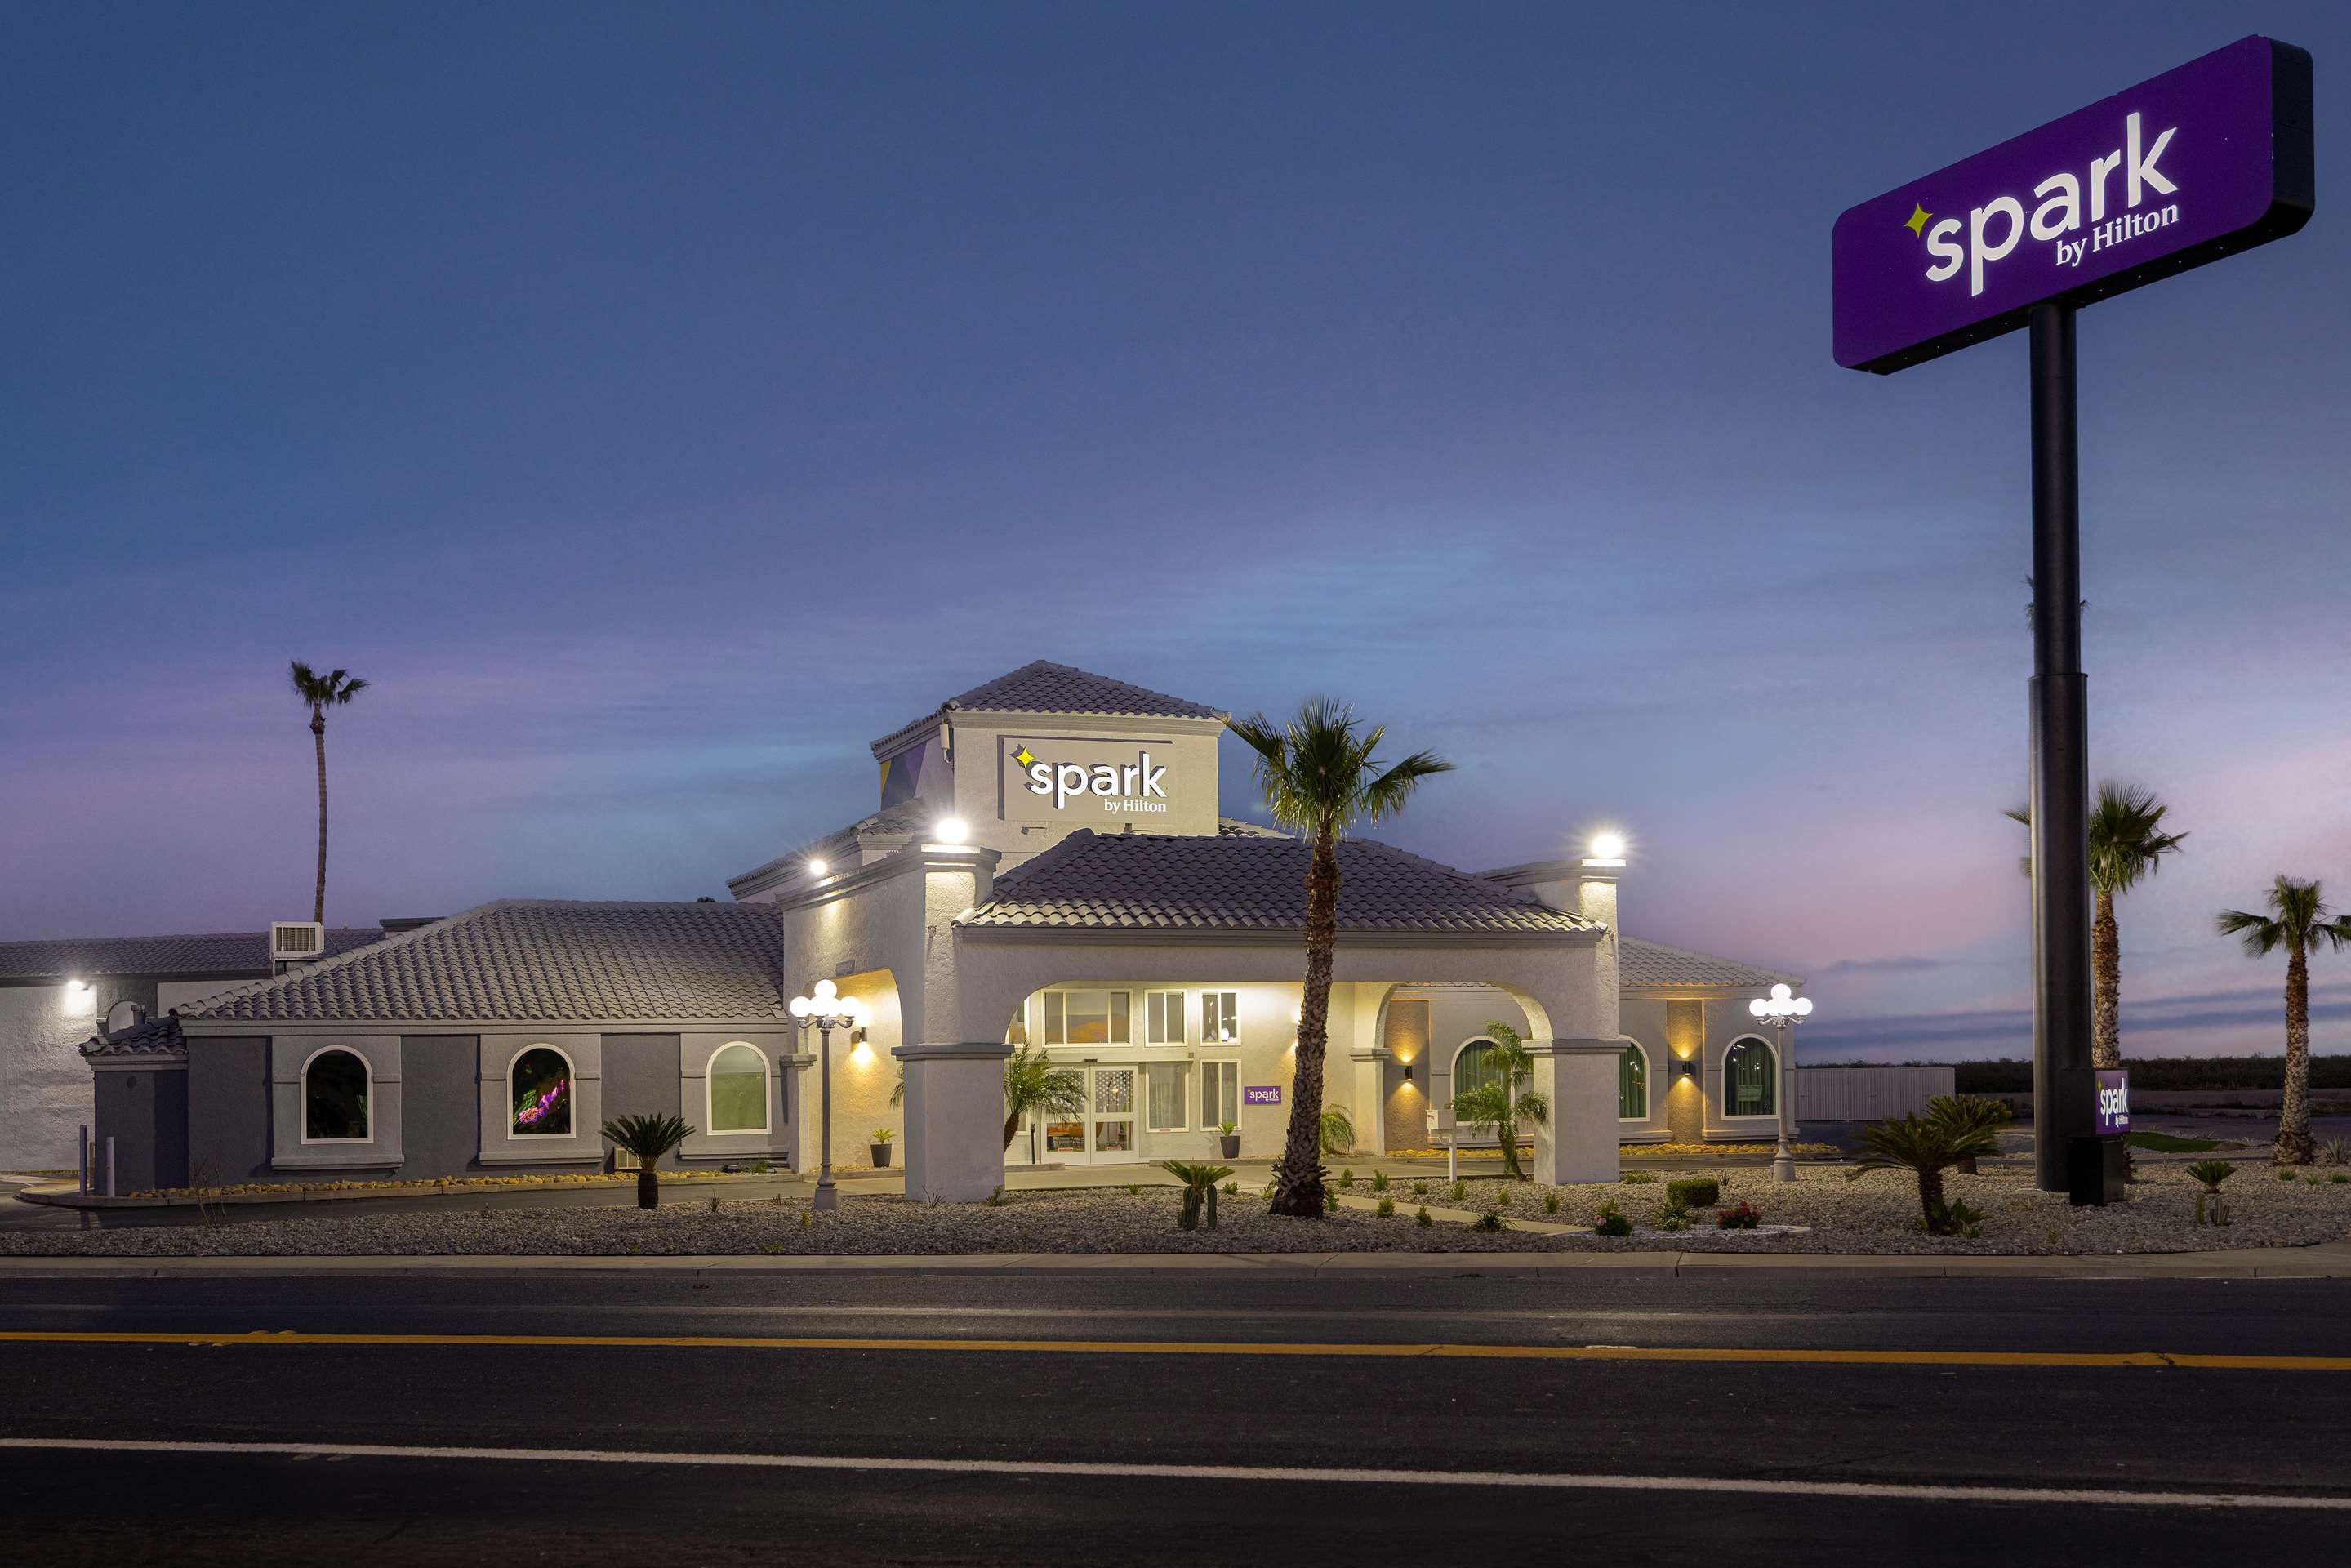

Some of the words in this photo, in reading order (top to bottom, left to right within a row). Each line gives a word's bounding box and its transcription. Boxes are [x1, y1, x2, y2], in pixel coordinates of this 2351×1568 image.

[1926, 112, 2179, 296] spark
[2056, 238, 2088, 267] by
[2092, 204, 2180, 252] Hilton
[1029, 751, 1169, 809] spark
[1104, 799, 1120, 814] by
[1123, 799, 1167, 812] Hilton
[1249, 1088, 1279, 1102] spark
[2100, 1077, 2128, 1126] spark
